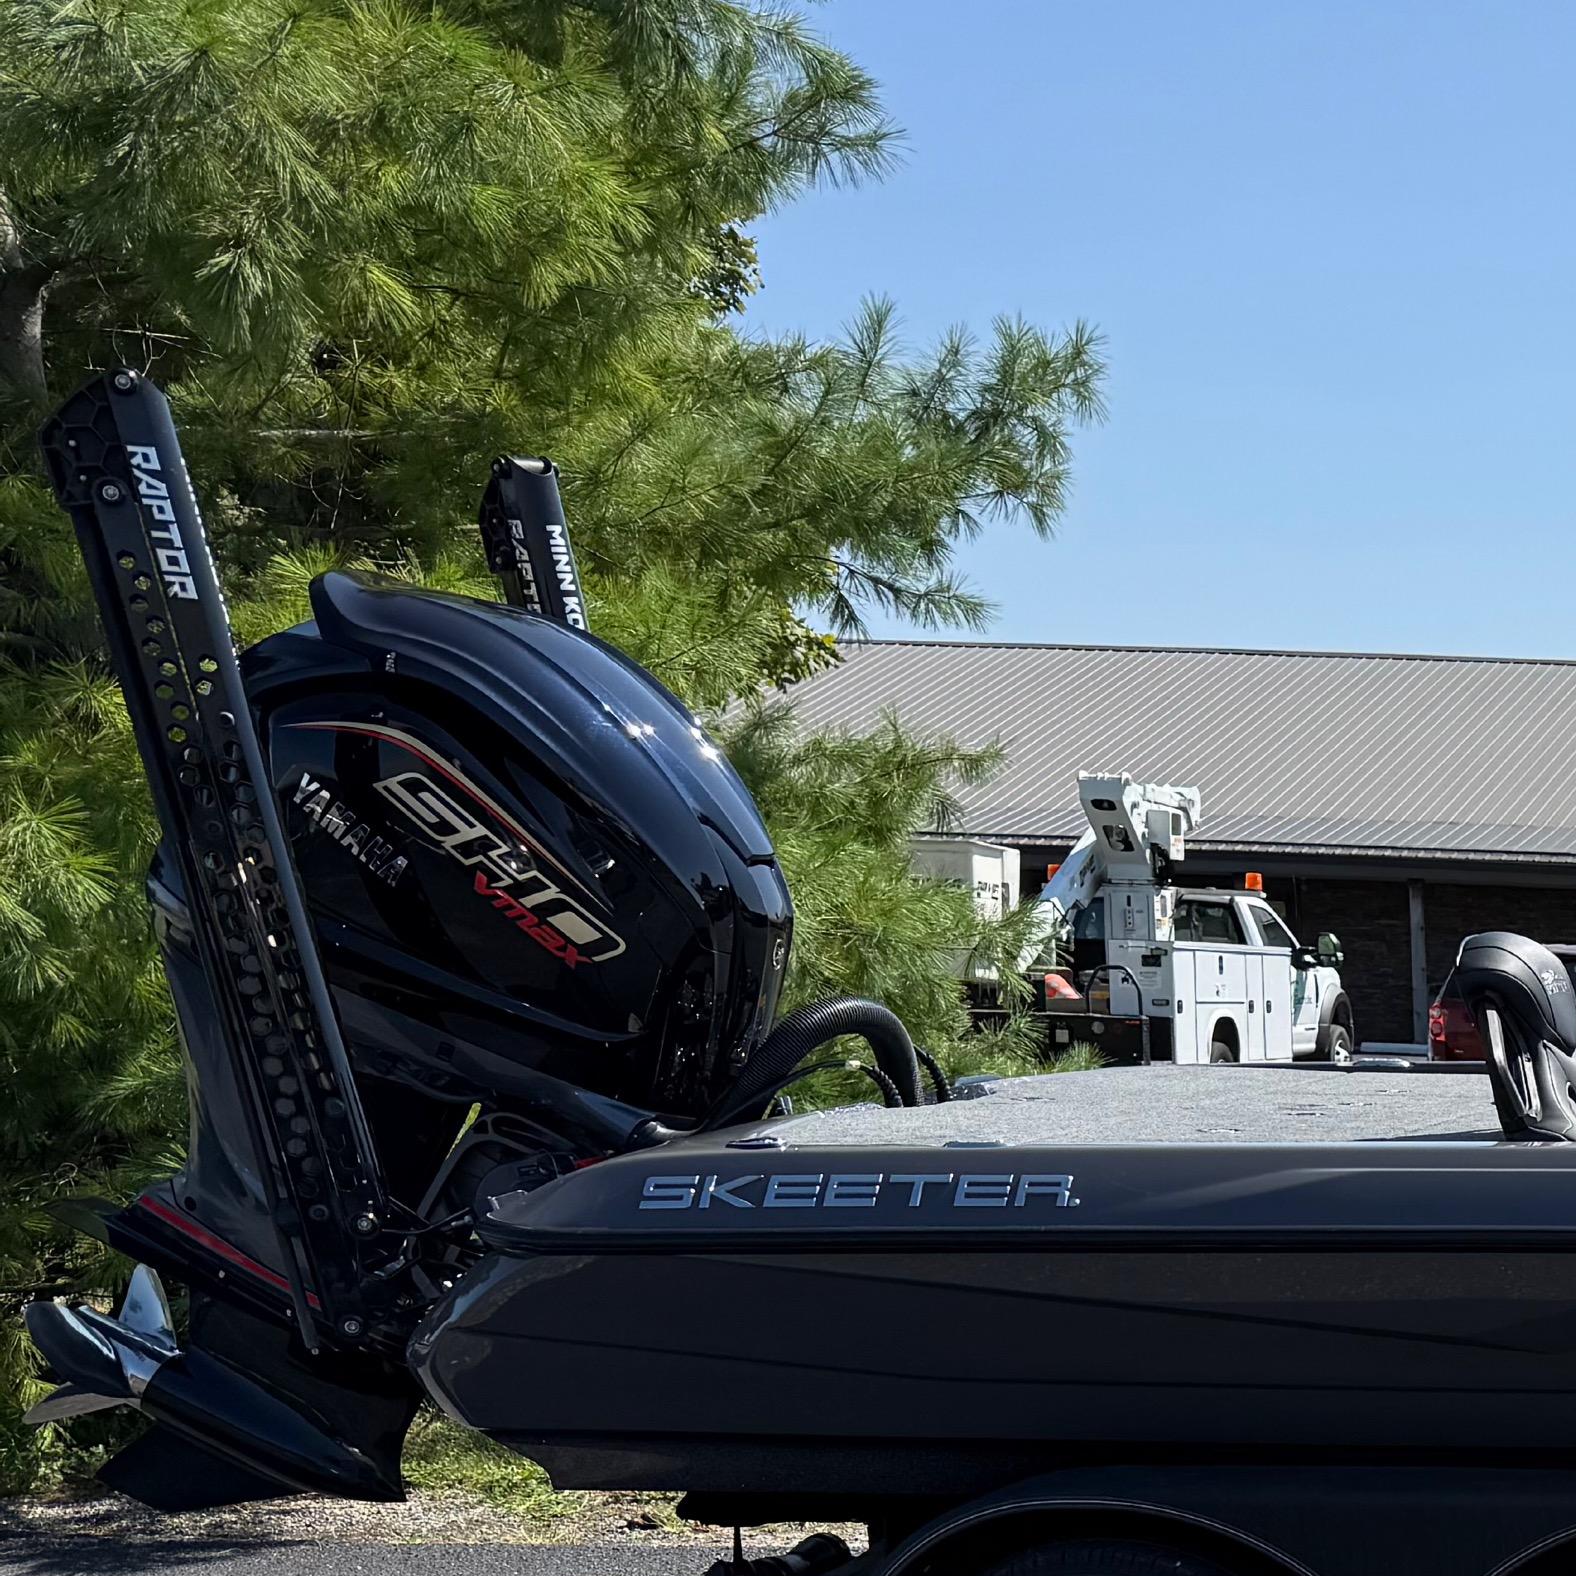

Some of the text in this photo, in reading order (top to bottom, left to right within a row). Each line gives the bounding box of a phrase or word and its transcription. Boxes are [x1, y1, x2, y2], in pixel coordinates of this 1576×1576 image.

[126, 445, 199, 600] RAPTOR
[546, 525, 586, 631] MINN KO
[292, 771, 409, 887] YAMAHA
[372, 771, 627, 963] SHO
[638, 1173, 1076, 1209] SKEETER
